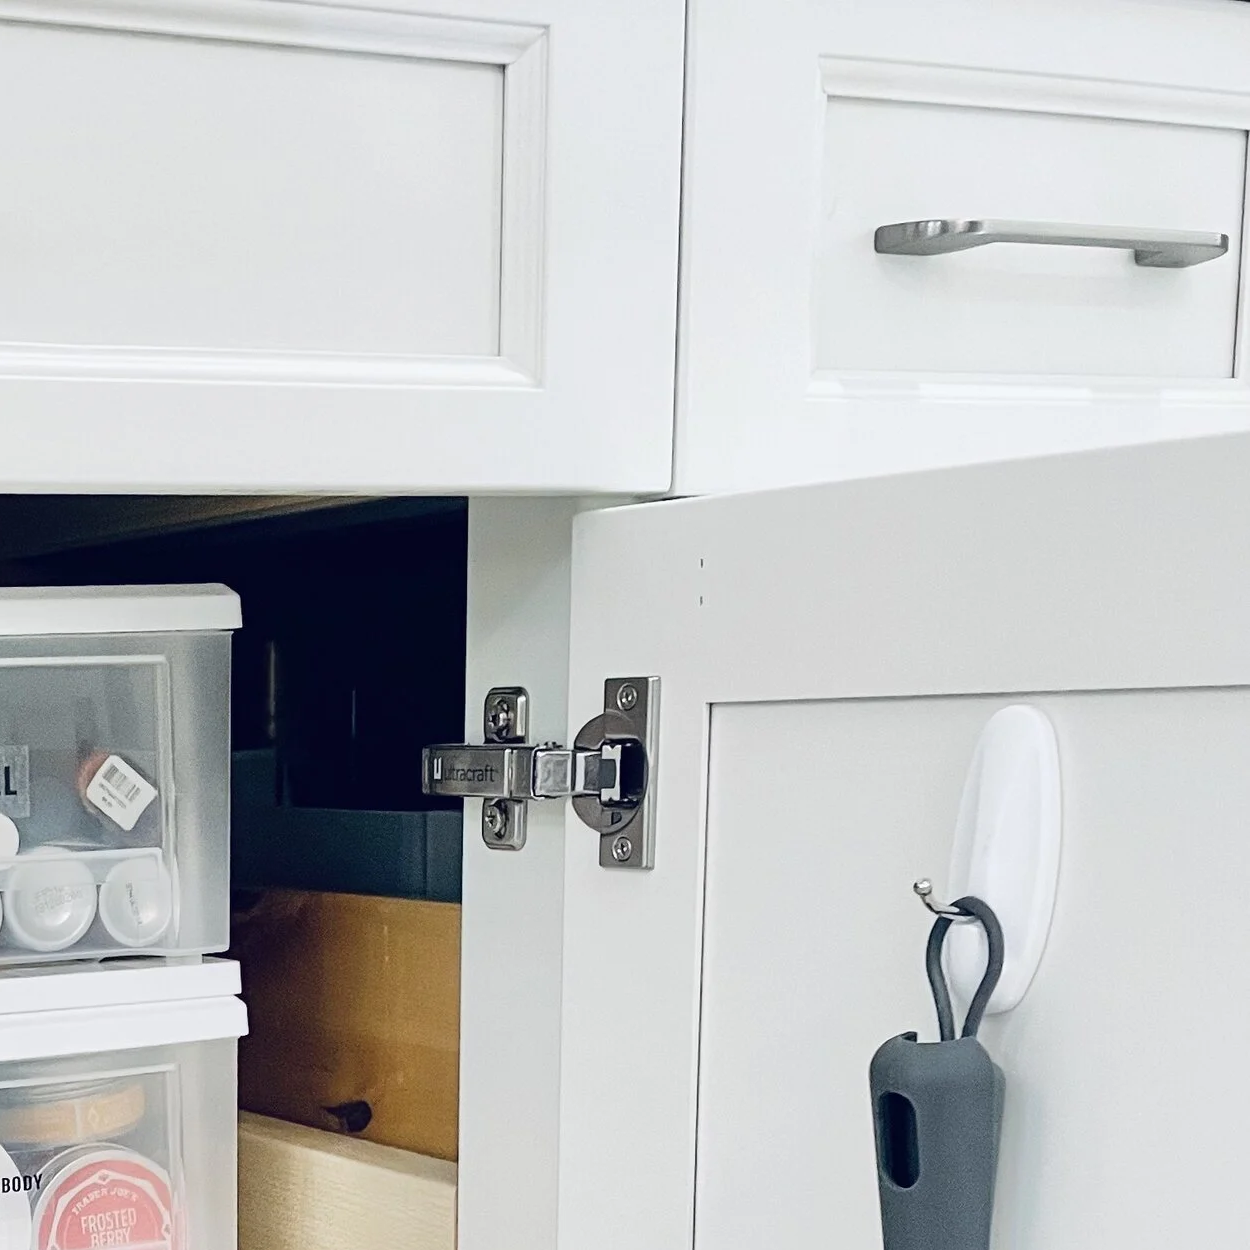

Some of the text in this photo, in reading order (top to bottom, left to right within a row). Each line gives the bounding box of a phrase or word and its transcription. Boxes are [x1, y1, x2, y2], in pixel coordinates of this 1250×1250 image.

[1, 1173, 43, 1193] BODY
[80, 1207, 138, 1235] FROSTED
[90, 1226, 131, 1250] BERRY
